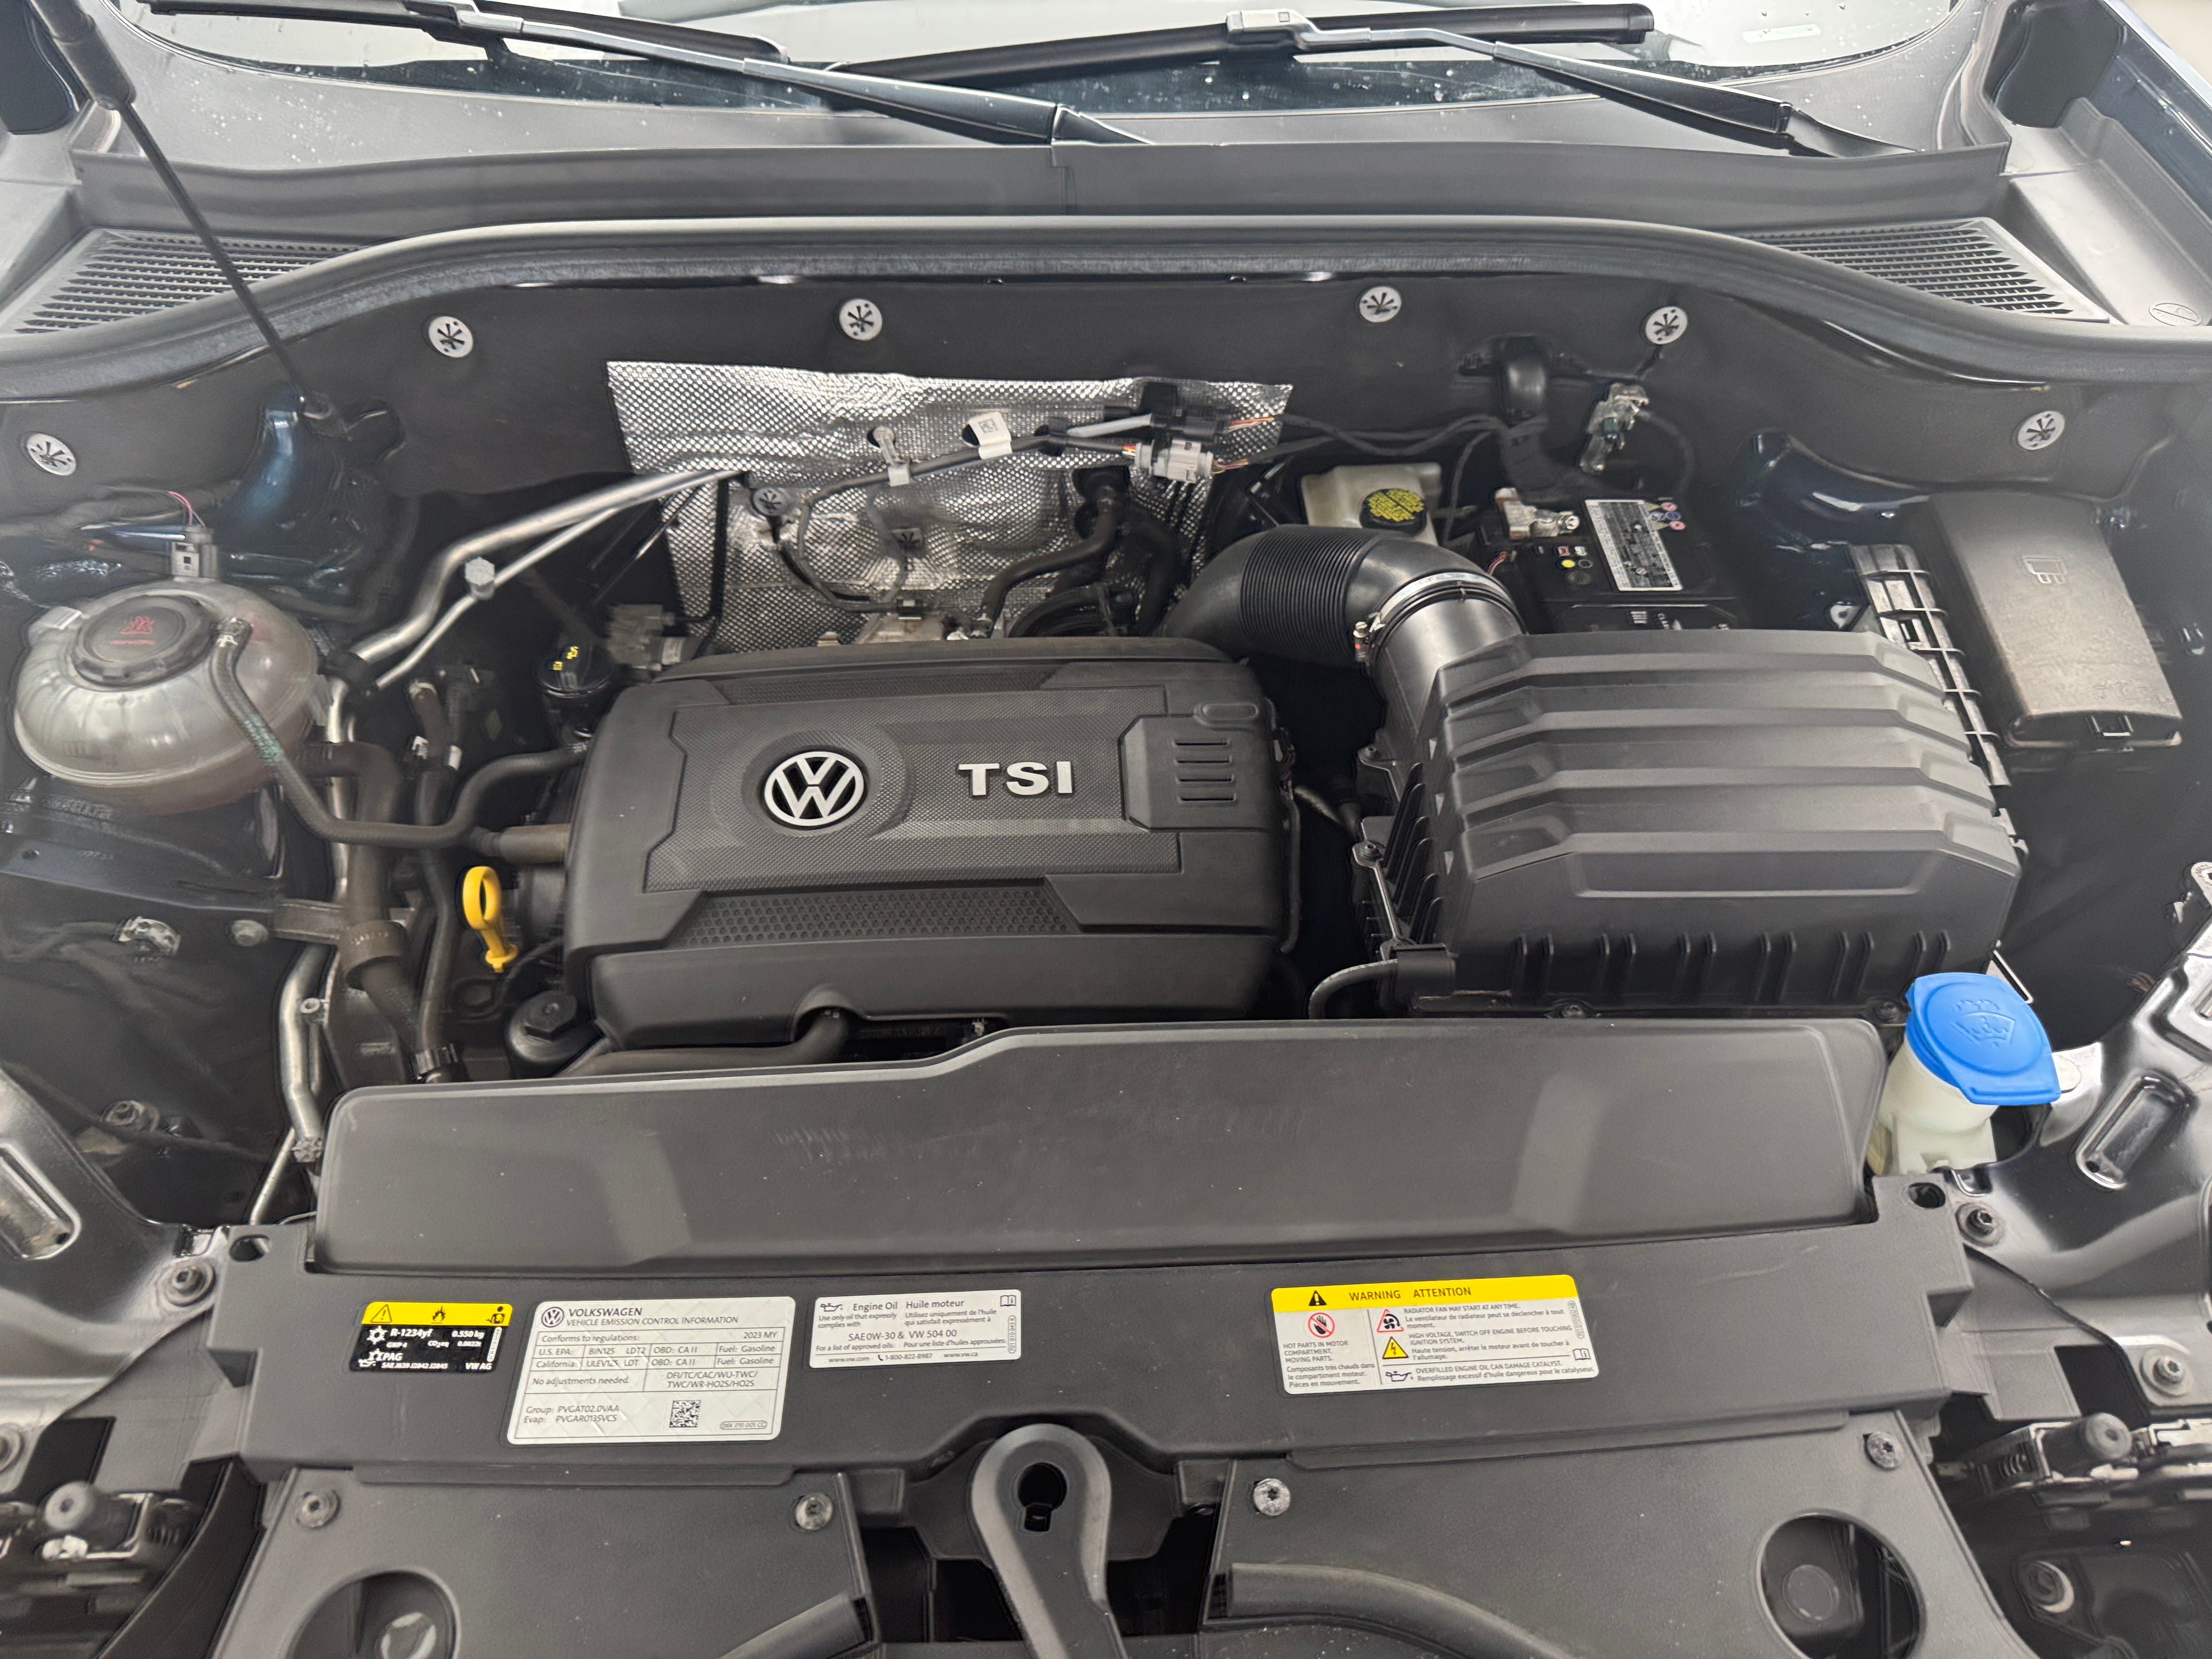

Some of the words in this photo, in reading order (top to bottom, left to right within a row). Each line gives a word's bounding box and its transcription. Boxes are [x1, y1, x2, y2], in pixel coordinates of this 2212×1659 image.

[958, 761, 1073, 796] TSI
[1349, 1290, 1401, 1301] WARNING
[1413, 1287, 1471, 1298] ATTENTION
[853, 1303, 883, 1312] Engine
[885, 1301, 898, 1310] Oil
[906, 1300, 929, 1309] Huile
[932, 1300, 965, 1308] moteur
[568, 1307, 642, 1317] VOLKSWAGEN
[390, 1328, 433, 1339] R-1234yf
[474, 1330, 484, 1339] kg
[898, 1331, 905, 1339] &
[909, 1330, 924, 1339] VW
[926, 1329, 944, 1338] 504
[945, 1329, 957, 1337] 00
[592, 1334, 639, 1344] regulations:
[741, 1344, 776, 1352] Gasoline
[382, 1352, 403, 1361] PAG
[545, 1378, 597, 1386] adjustments
[598, 1376, 629, 1384] needed.
[526, 1406, 555, 1415] Group:
[523, 1415, 546, 1425] Evap:
